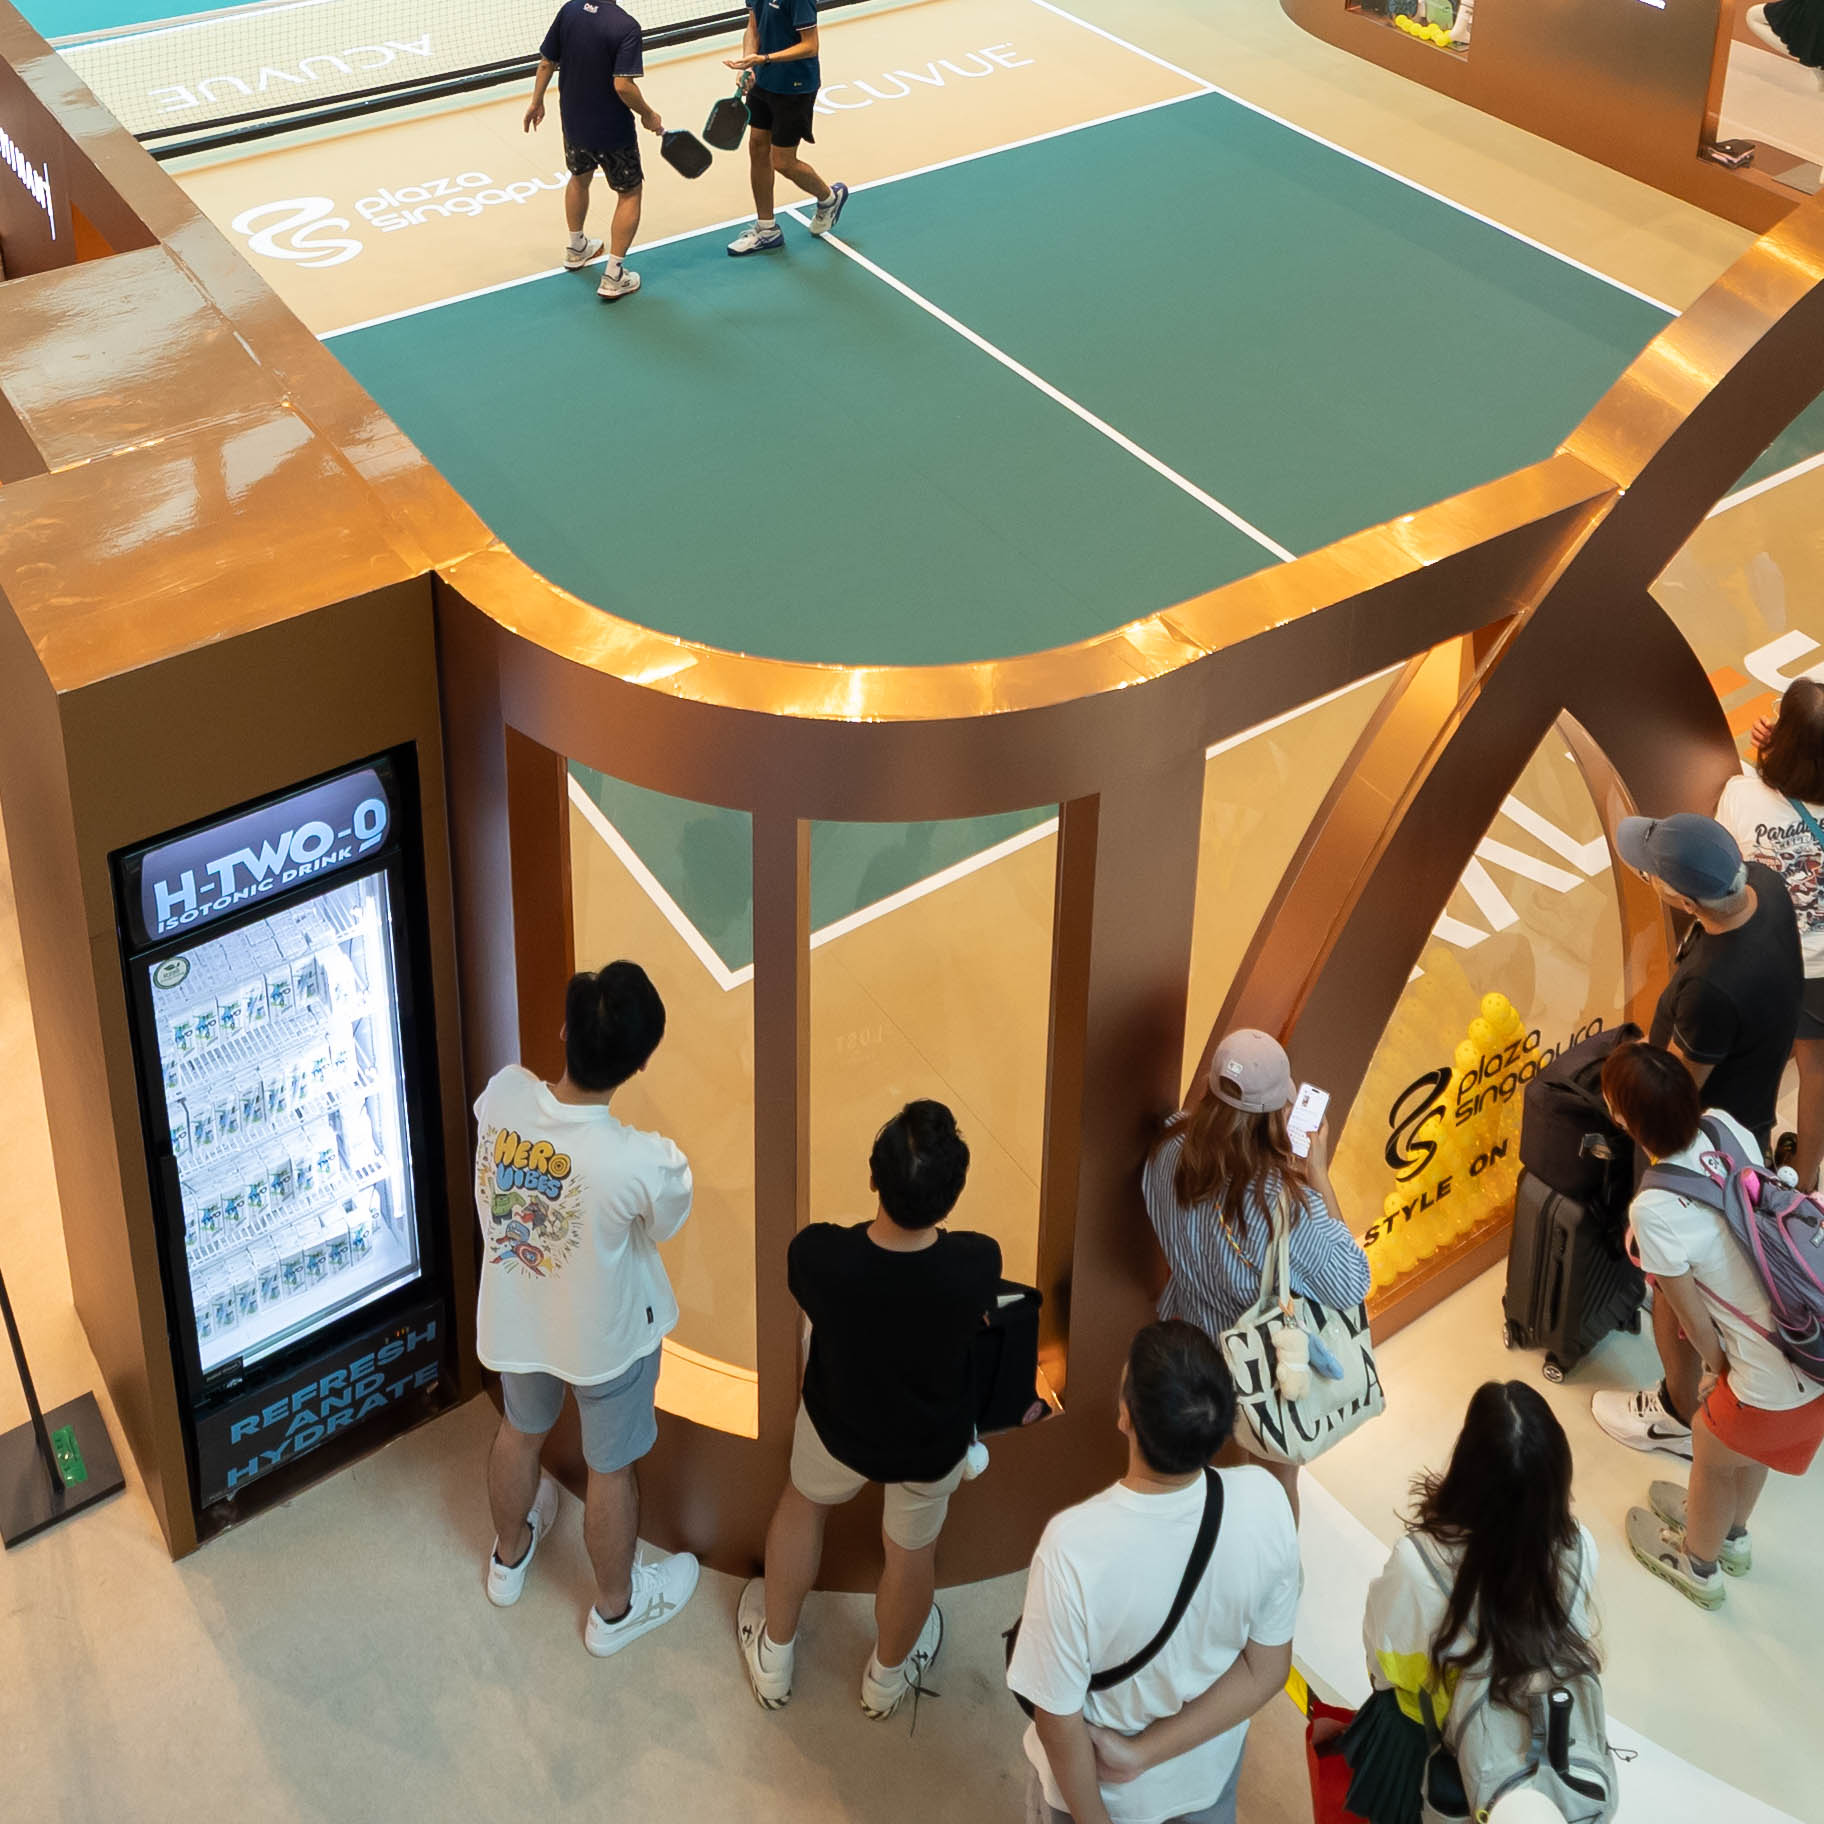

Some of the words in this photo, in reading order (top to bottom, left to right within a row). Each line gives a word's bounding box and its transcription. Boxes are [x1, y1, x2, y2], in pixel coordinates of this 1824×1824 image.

[147, 33, 434, 113] ACUVUE
[355, 171, 495, 220] plaza
[371, 169, 607, 233] singapu
[157, 869, 275, 933] ISOTONIC
[280, 841, 356, 893] DRINK
[1456, 1029, 1541, 1106] plaza
[495, 1128, 573, 1178] HERO
[496, 1161, 565, 1202] VIBES
[1363, 1175, 1452, 1248] STYLE
[1469, 1138, 1508, 1178] ON
[229, 1321, 439, 1444] REFRESH
[285, 1372, 387, 1432] AND
[225, 1359, 441, 1488] HYDRATE
